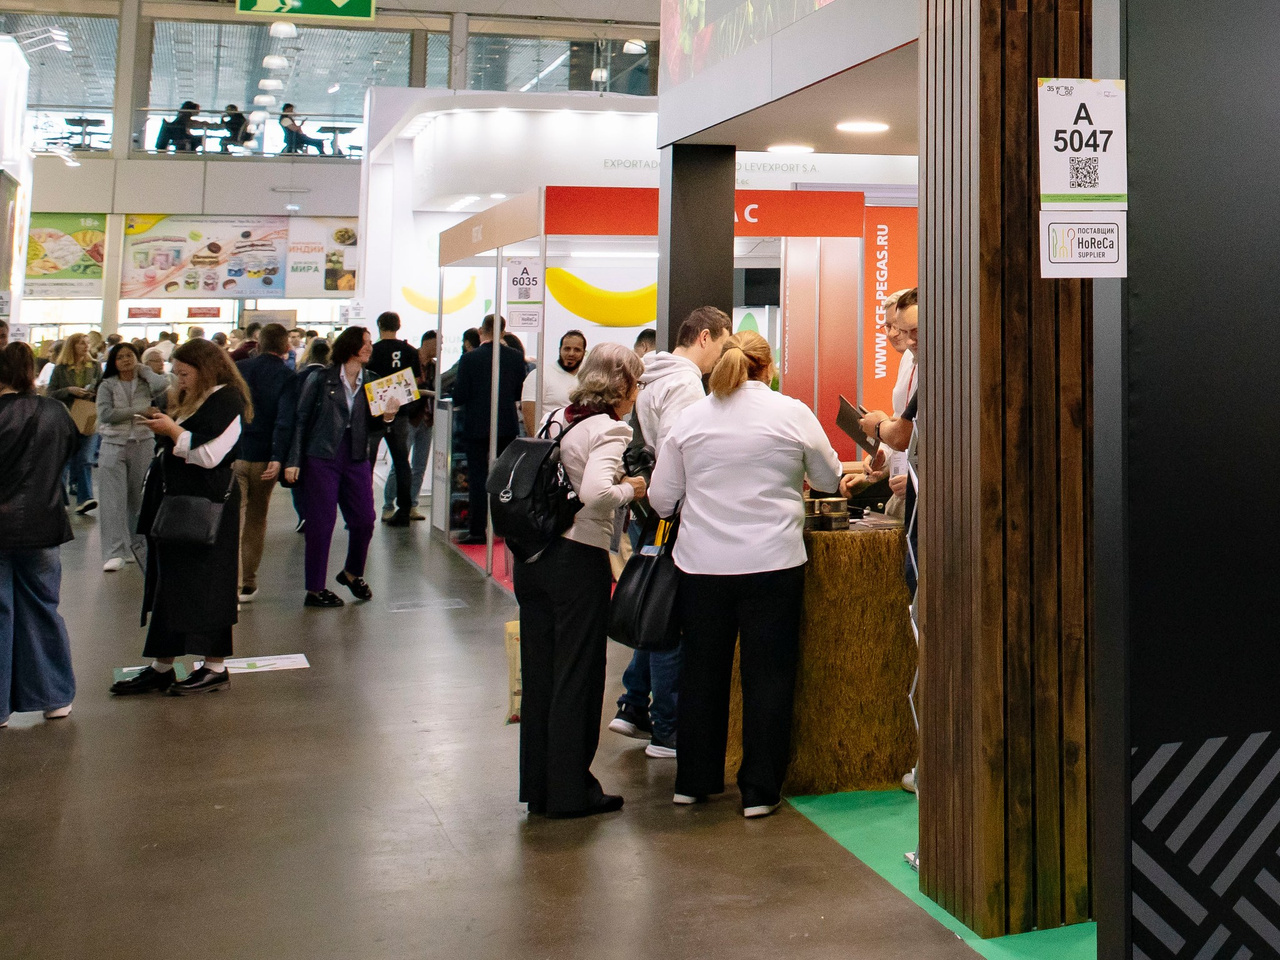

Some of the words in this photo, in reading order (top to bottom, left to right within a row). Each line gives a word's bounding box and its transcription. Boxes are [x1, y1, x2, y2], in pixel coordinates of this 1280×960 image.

[1073, 102, 1094, 125] A
[1053, 129, 1113, 153] 5047
[603, 158, 660, 169] EXPORTAD
[744, 162, 800, 172] LEVEXPORT
[802, 163, 820, 173] S.A.
[1077, 227, 1115, 235] ПОСТАВЩИК
[1077, 237, 1114, 249] HoReCa
[291, 265, 320, 273] МИРА
[520, 267, 529, 276] A
[512, 277, 538, 286] 6035
[874, 224, 889, 379] WWWCE-PEGAS.RU
